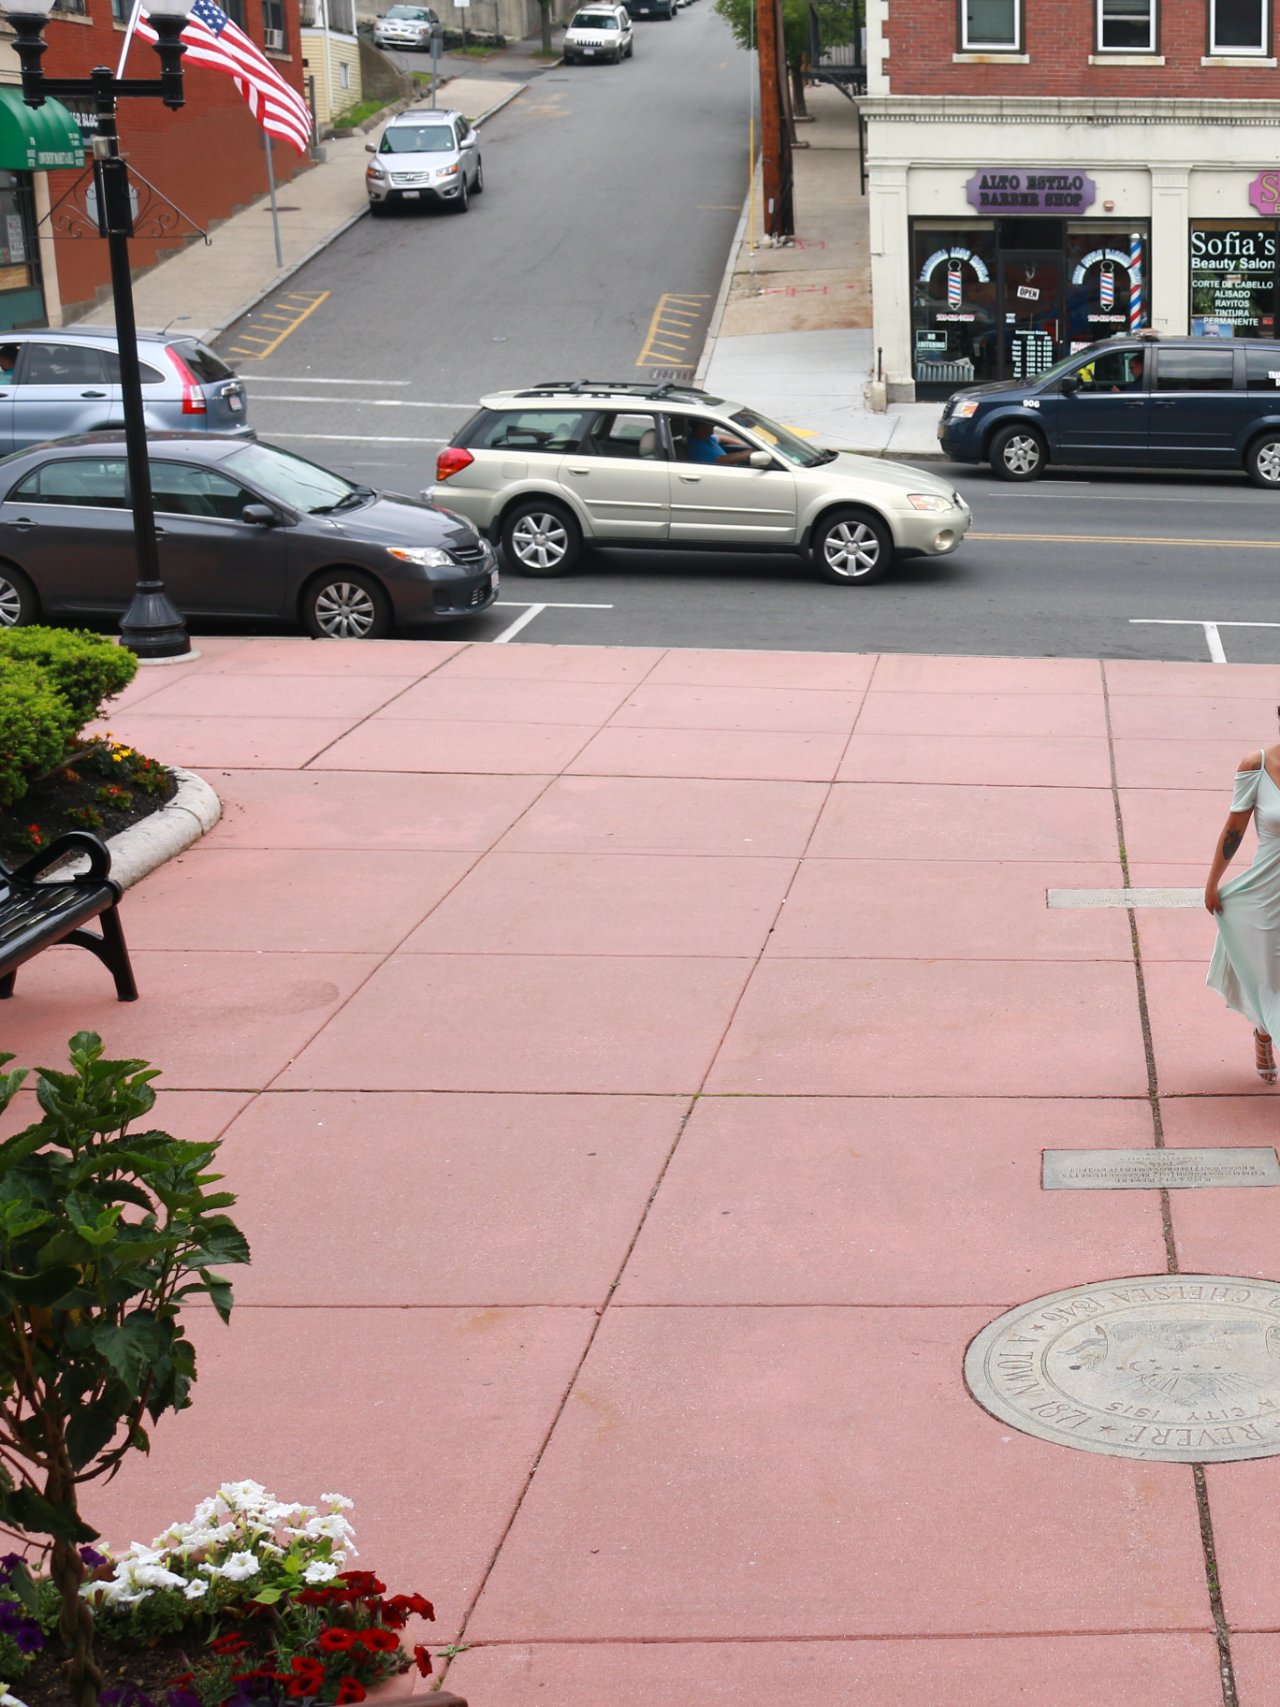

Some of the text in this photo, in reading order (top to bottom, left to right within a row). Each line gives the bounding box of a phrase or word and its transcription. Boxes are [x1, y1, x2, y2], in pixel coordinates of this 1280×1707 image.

[979, 175, 1083, 190] ALTO ESTILO
[979, 192, 1082, 207] BARBER SHOP
[1191, 231, 1276, 256] Sofia's
[1191, 257, 1276, 271] Beauty Salon
[1192, 280, 1220, 288] CORTE
[1236, 281, 1274, 289] CABELLO
[1019, 287, 1038, 298] OPEN
[1214, 290, 1251, 298] ALISADO
[1214, 299, 1250, 308] RAYITOS
[1214, 309, 1250, 317] TINTURA
[1203, 317, 1259, 326] PERMANENTE
[1023, 399, 1040, 408] 906
[1112, 1286, 1251, 1303] CHELSEA
[1041, 1297, 1105, 1323] 1846
[997, 1352, 1045, 1396] TOWN
[1029, 1400, 1094, 1429] 1871
[1106, 1398, 1276, 1421] A CITY 1915
[1125, 1423, 1264, 1446] REVERE
